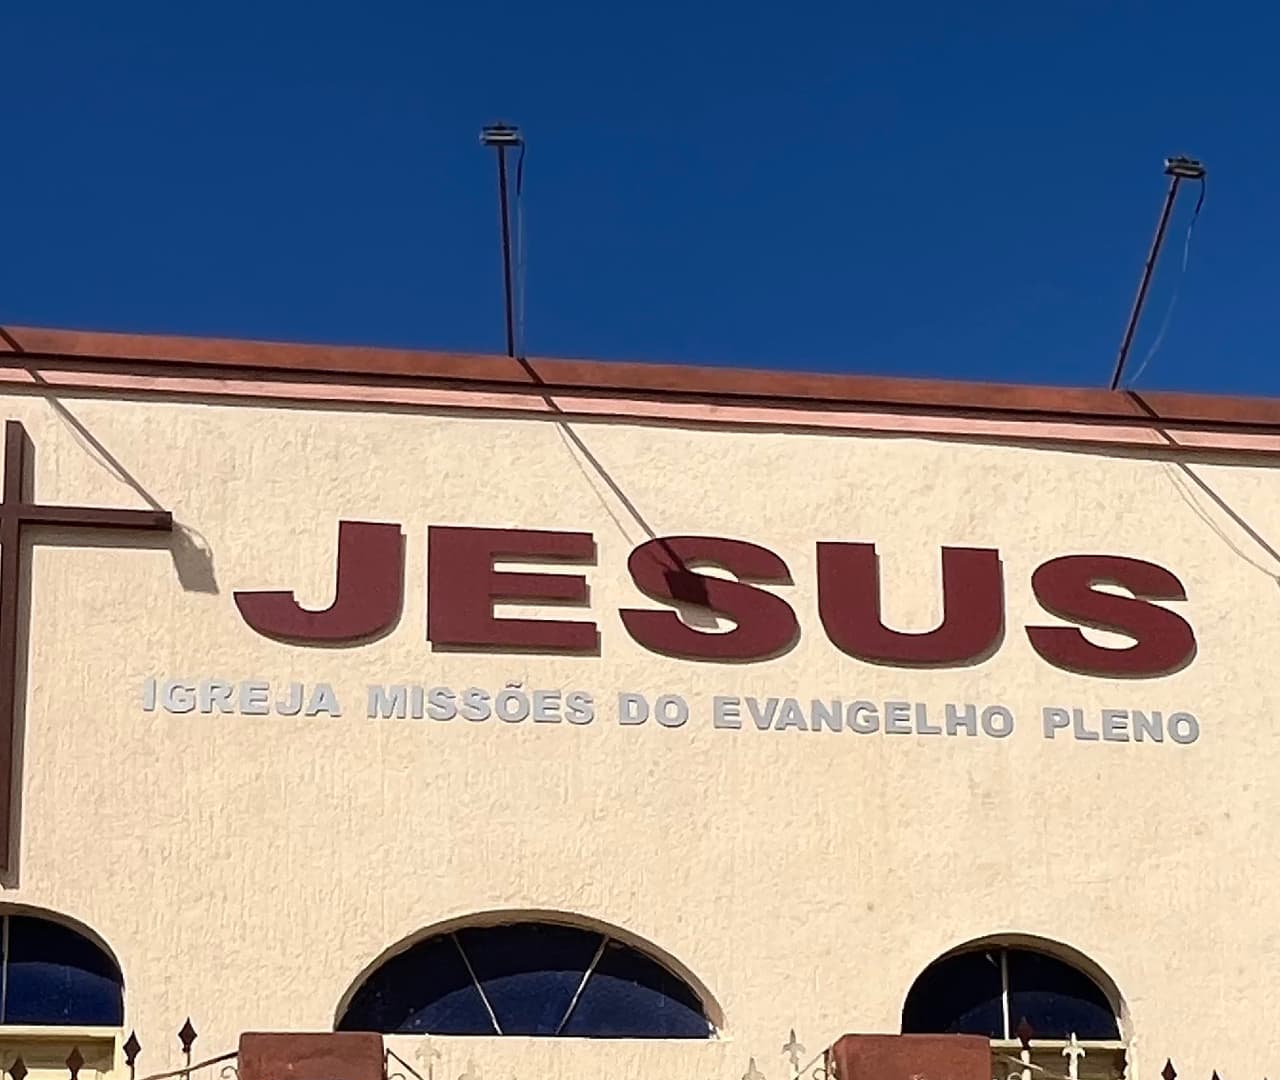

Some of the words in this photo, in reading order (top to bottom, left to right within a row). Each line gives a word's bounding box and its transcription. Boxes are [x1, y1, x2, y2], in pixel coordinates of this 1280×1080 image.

[233, 520, 1198, 679] JESUS
[142, 677, 341, 718] IGREJA
[366, 680, 595, 726] MISSÕES
[618, 692, 689, 728] DO
[712, 696, 1014, 738] EVANGELHO
[1042, 706, 1200, 744] PLENO
